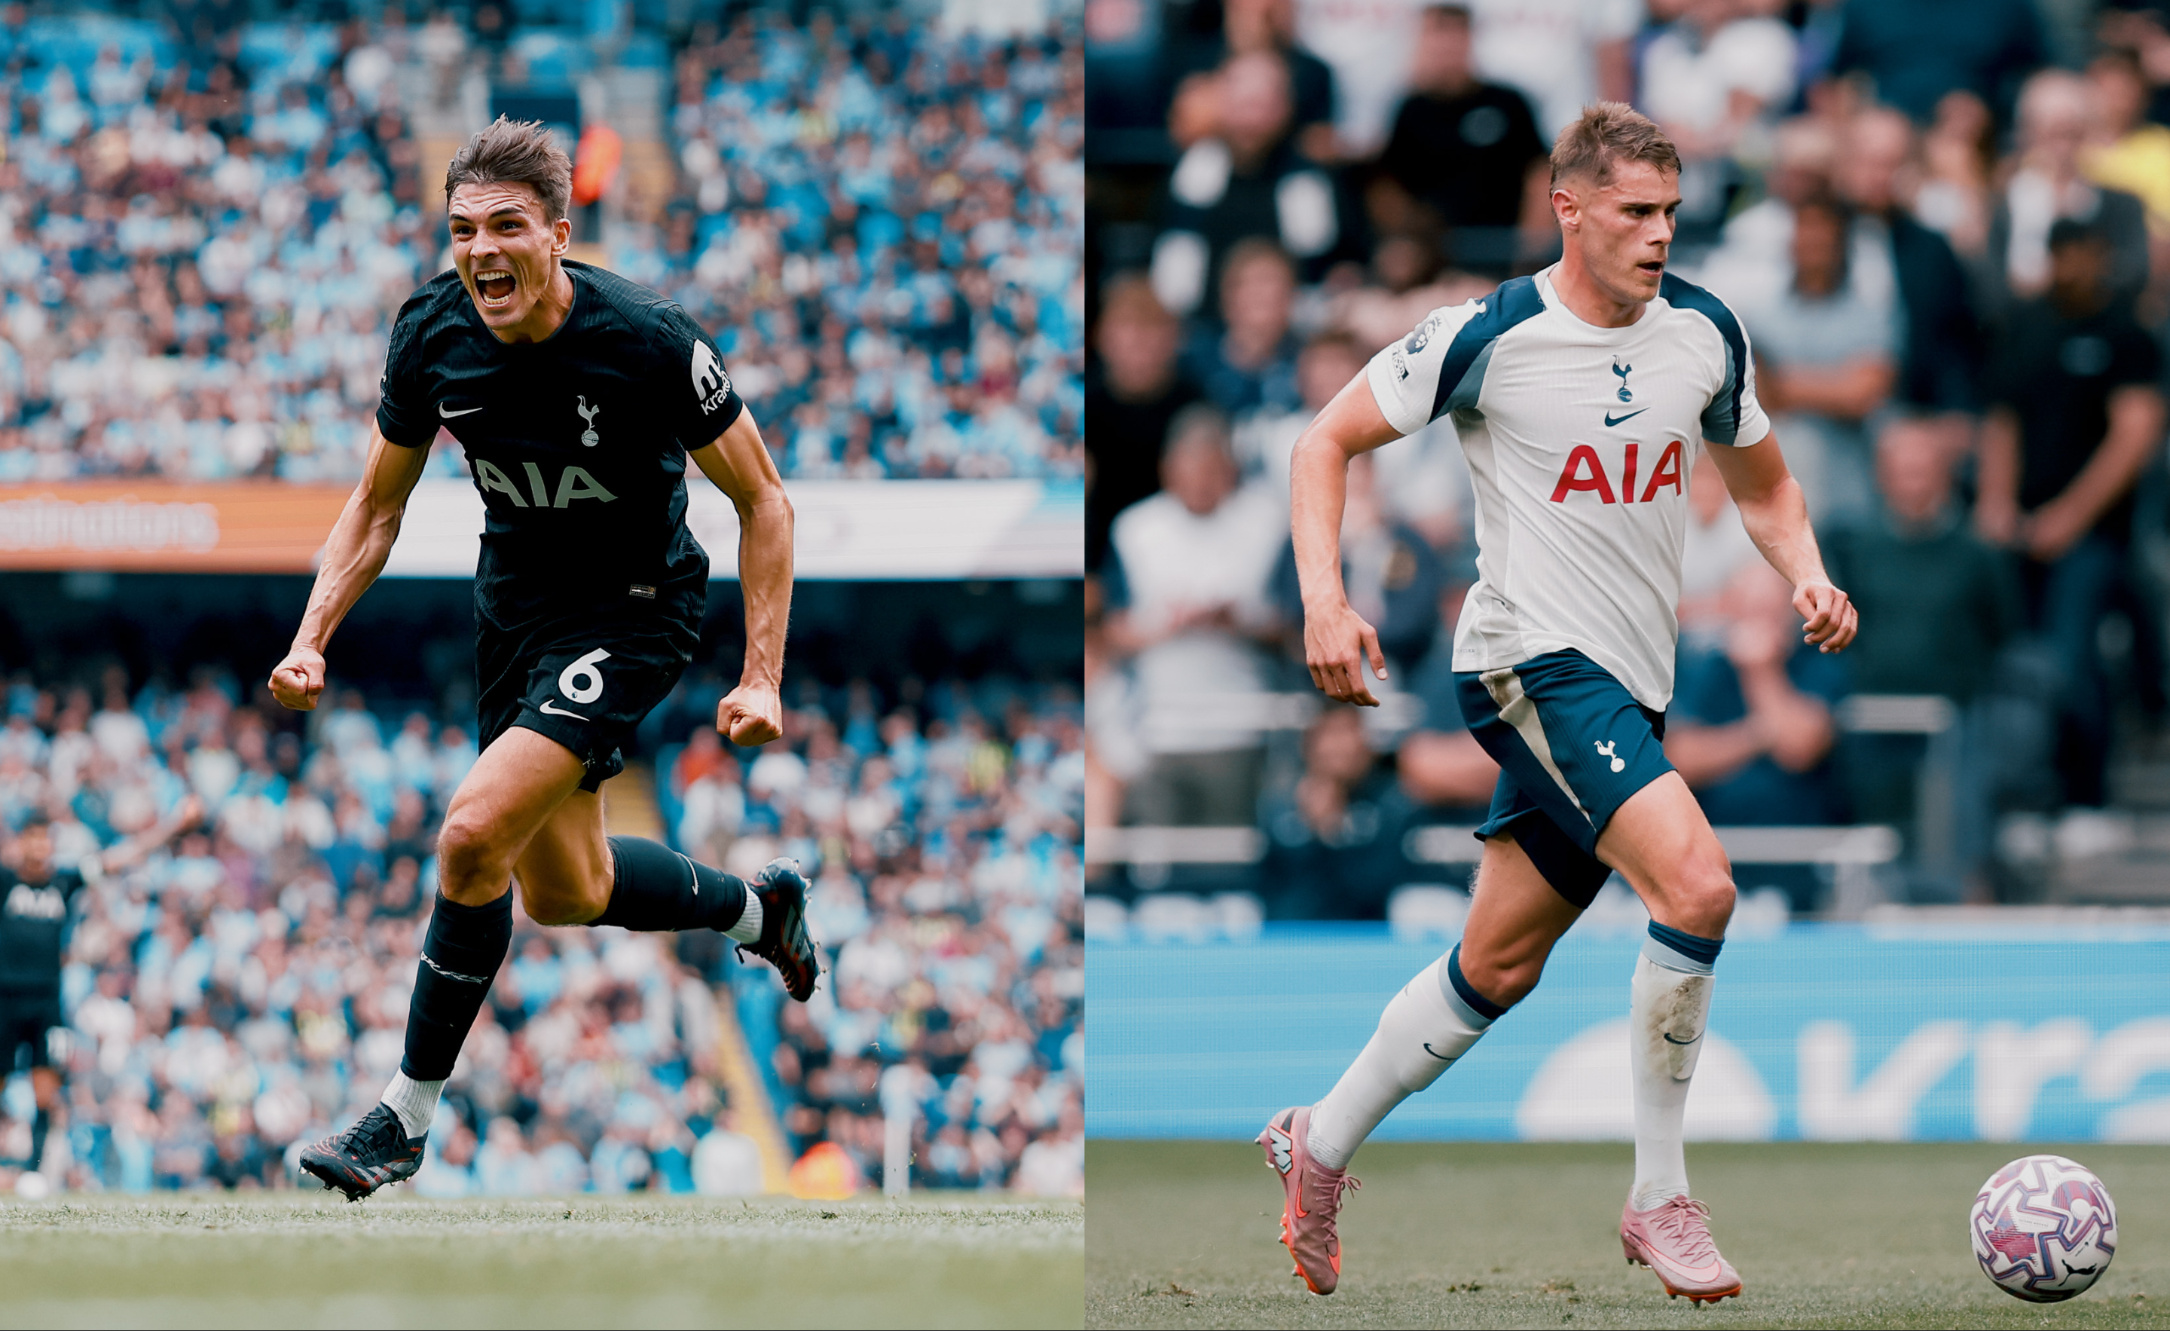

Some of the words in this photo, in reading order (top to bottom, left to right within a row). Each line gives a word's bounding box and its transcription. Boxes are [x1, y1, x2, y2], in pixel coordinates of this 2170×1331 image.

[475, 459, 618, 508] AIA
[1549, 440, 1682, 504] AIA
[558, 647, 612, 704] 6
